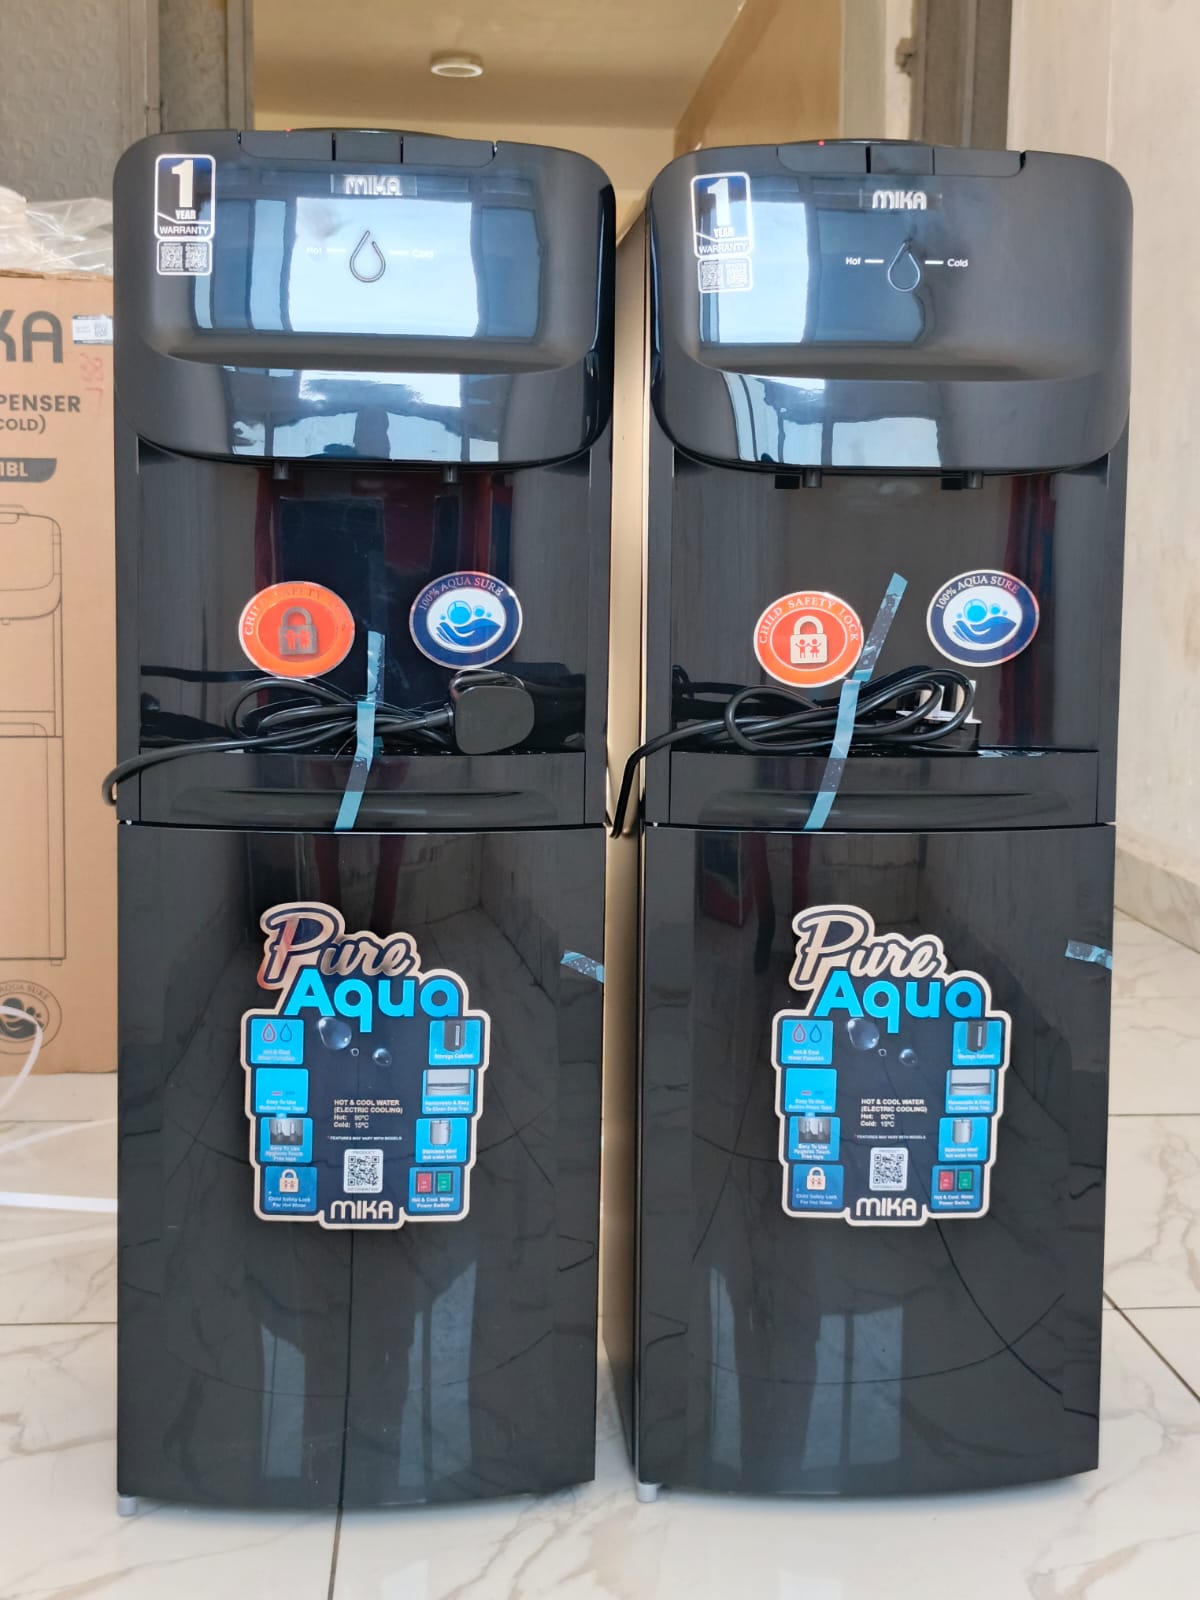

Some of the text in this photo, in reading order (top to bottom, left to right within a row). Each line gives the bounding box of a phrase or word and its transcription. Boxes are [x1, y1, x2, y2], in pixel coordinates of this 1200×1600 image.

[171, 159, 194, 208] 1
[344, 175, 403, 196] MIKA
[707, 178, 731, 227] 1
[872, 190, 927, 210] MIKA
[175, 209, 196, 220] YEAR
[160, 225, 209, 235] WARRANTY
[698, 242, 748, 255] WARRANTY
[845, 257, 861, 265] Hot
[947, 258, 969, 267] Cold
[419, 576, 504, 611] 100% AQUA SURE
[935, 575, 1020, 611] 100% AQUA SURE
[759, 596, 859, 644] CHILD SAFETY LOCK
[267, 912, 412, 981] Pure
[798, 914, 938, 982] Pure
[283, 968, 459, 1033] Aqua
[813, 970, 982, 1034] Aqua
[330, 1200, 394, 1219] MIKA
[856, 1197, 917, 1217] MIKA
